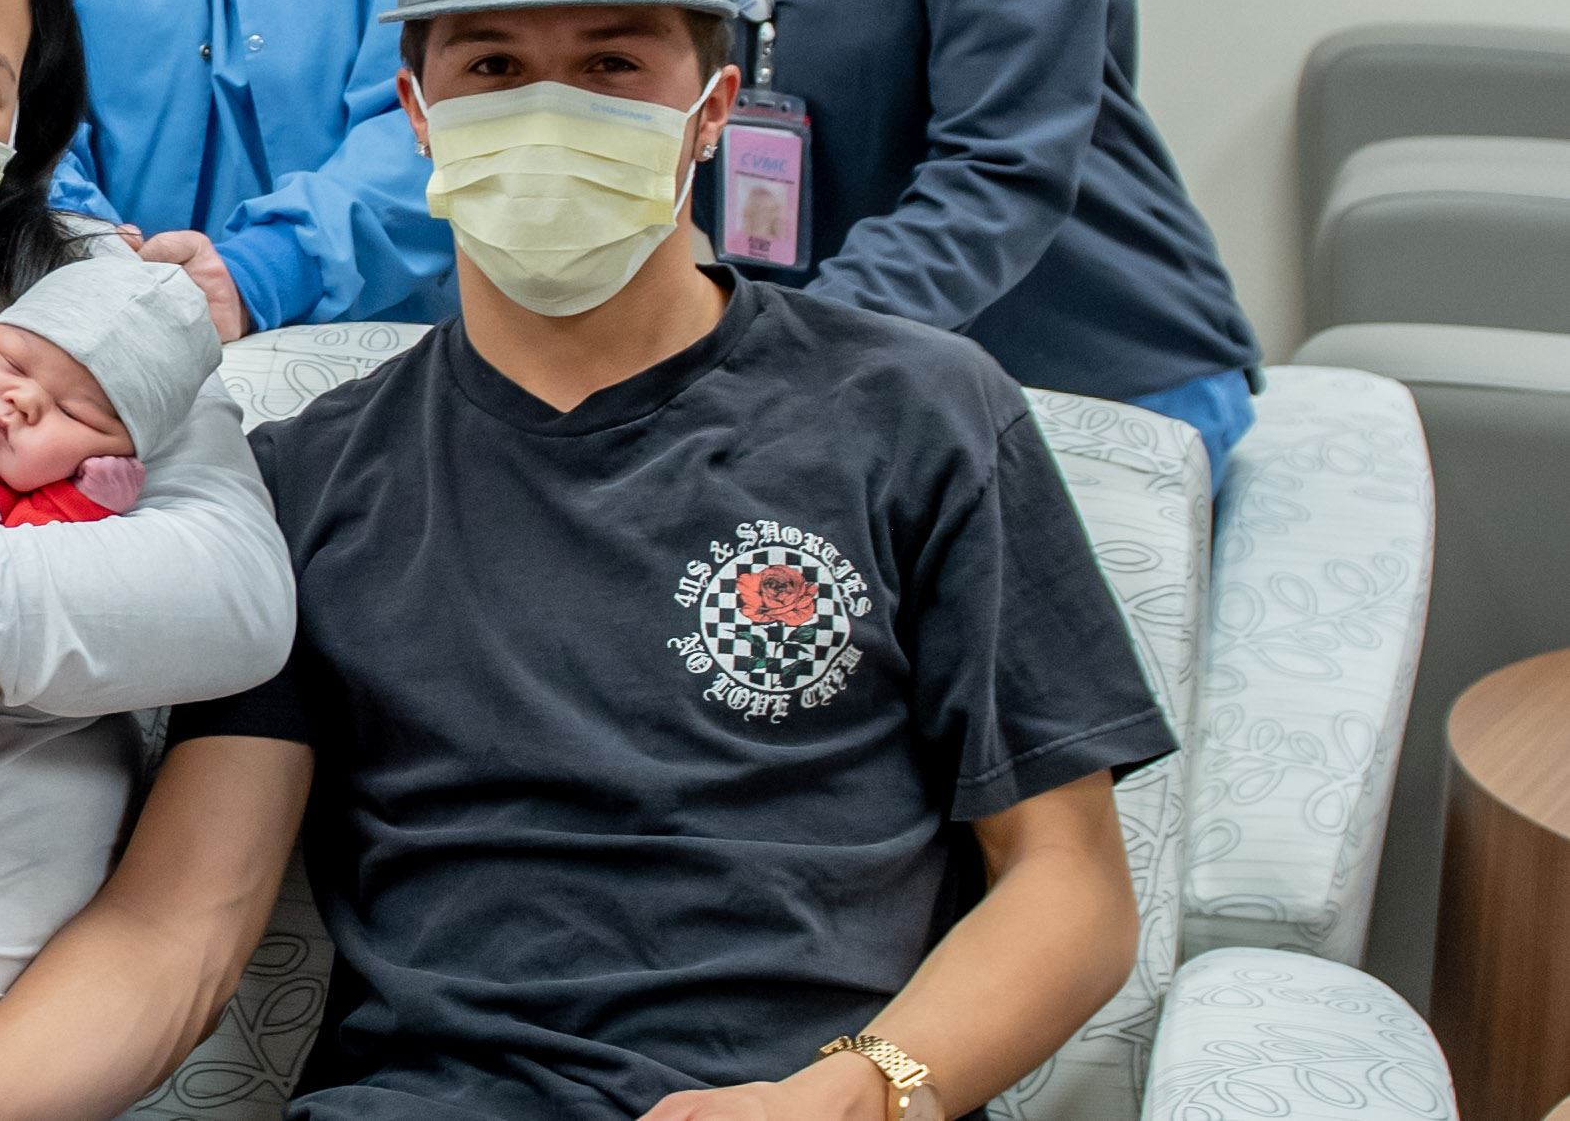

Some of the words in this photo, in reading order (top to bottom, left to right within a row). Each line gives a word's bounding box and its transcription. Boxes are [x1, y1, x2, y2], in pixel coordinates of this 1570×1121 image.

[709, 540, 734, 564] &
[735, 519, 873, 618] SHORTIES
[702, 672, 792, 724] LOVE
[800, 643, 864, 709] CREW
